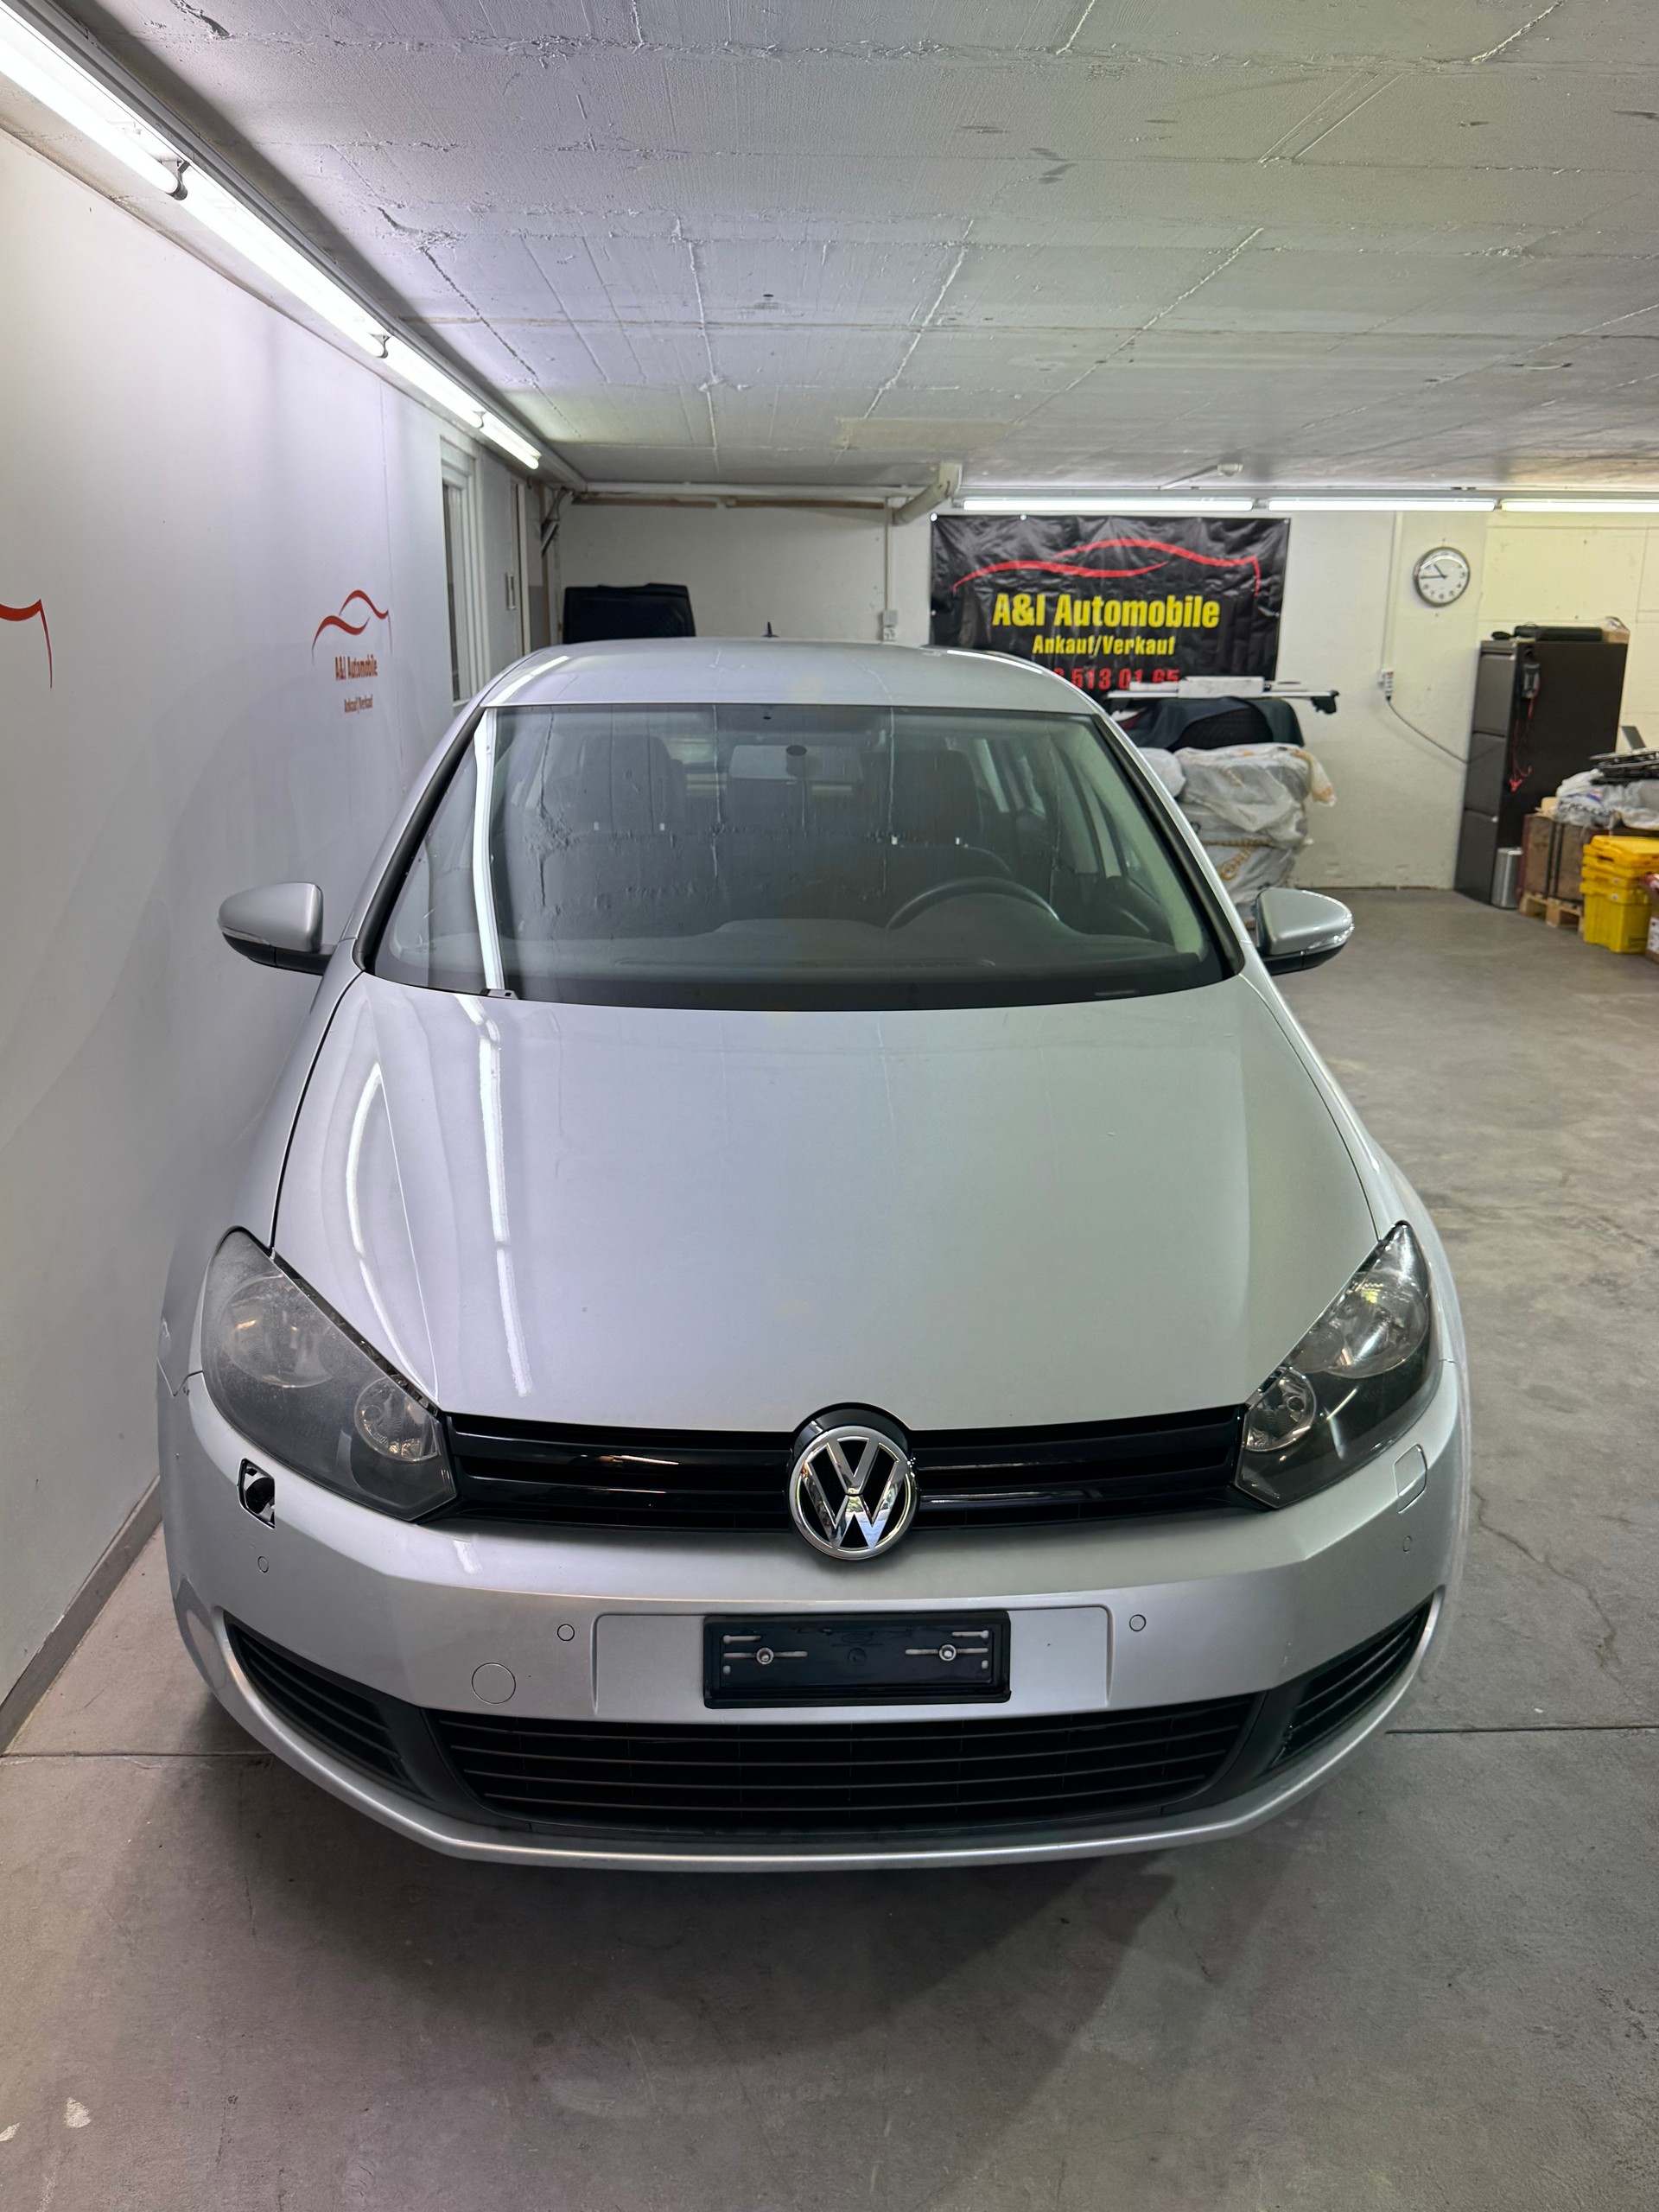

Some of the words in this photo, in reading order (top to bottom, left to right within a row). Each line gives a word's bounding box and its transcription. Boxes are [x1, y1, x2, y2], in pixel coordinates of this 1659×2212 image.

[992, 593, 1046, 626] A&I
[1053, 594, 1220, 627] Automobile
[1033, 634, 1175, 656] Ankauf/Verkauf
[1071, 668, 1111, 690] 513
[800, 1433, 912, 1552] VW
